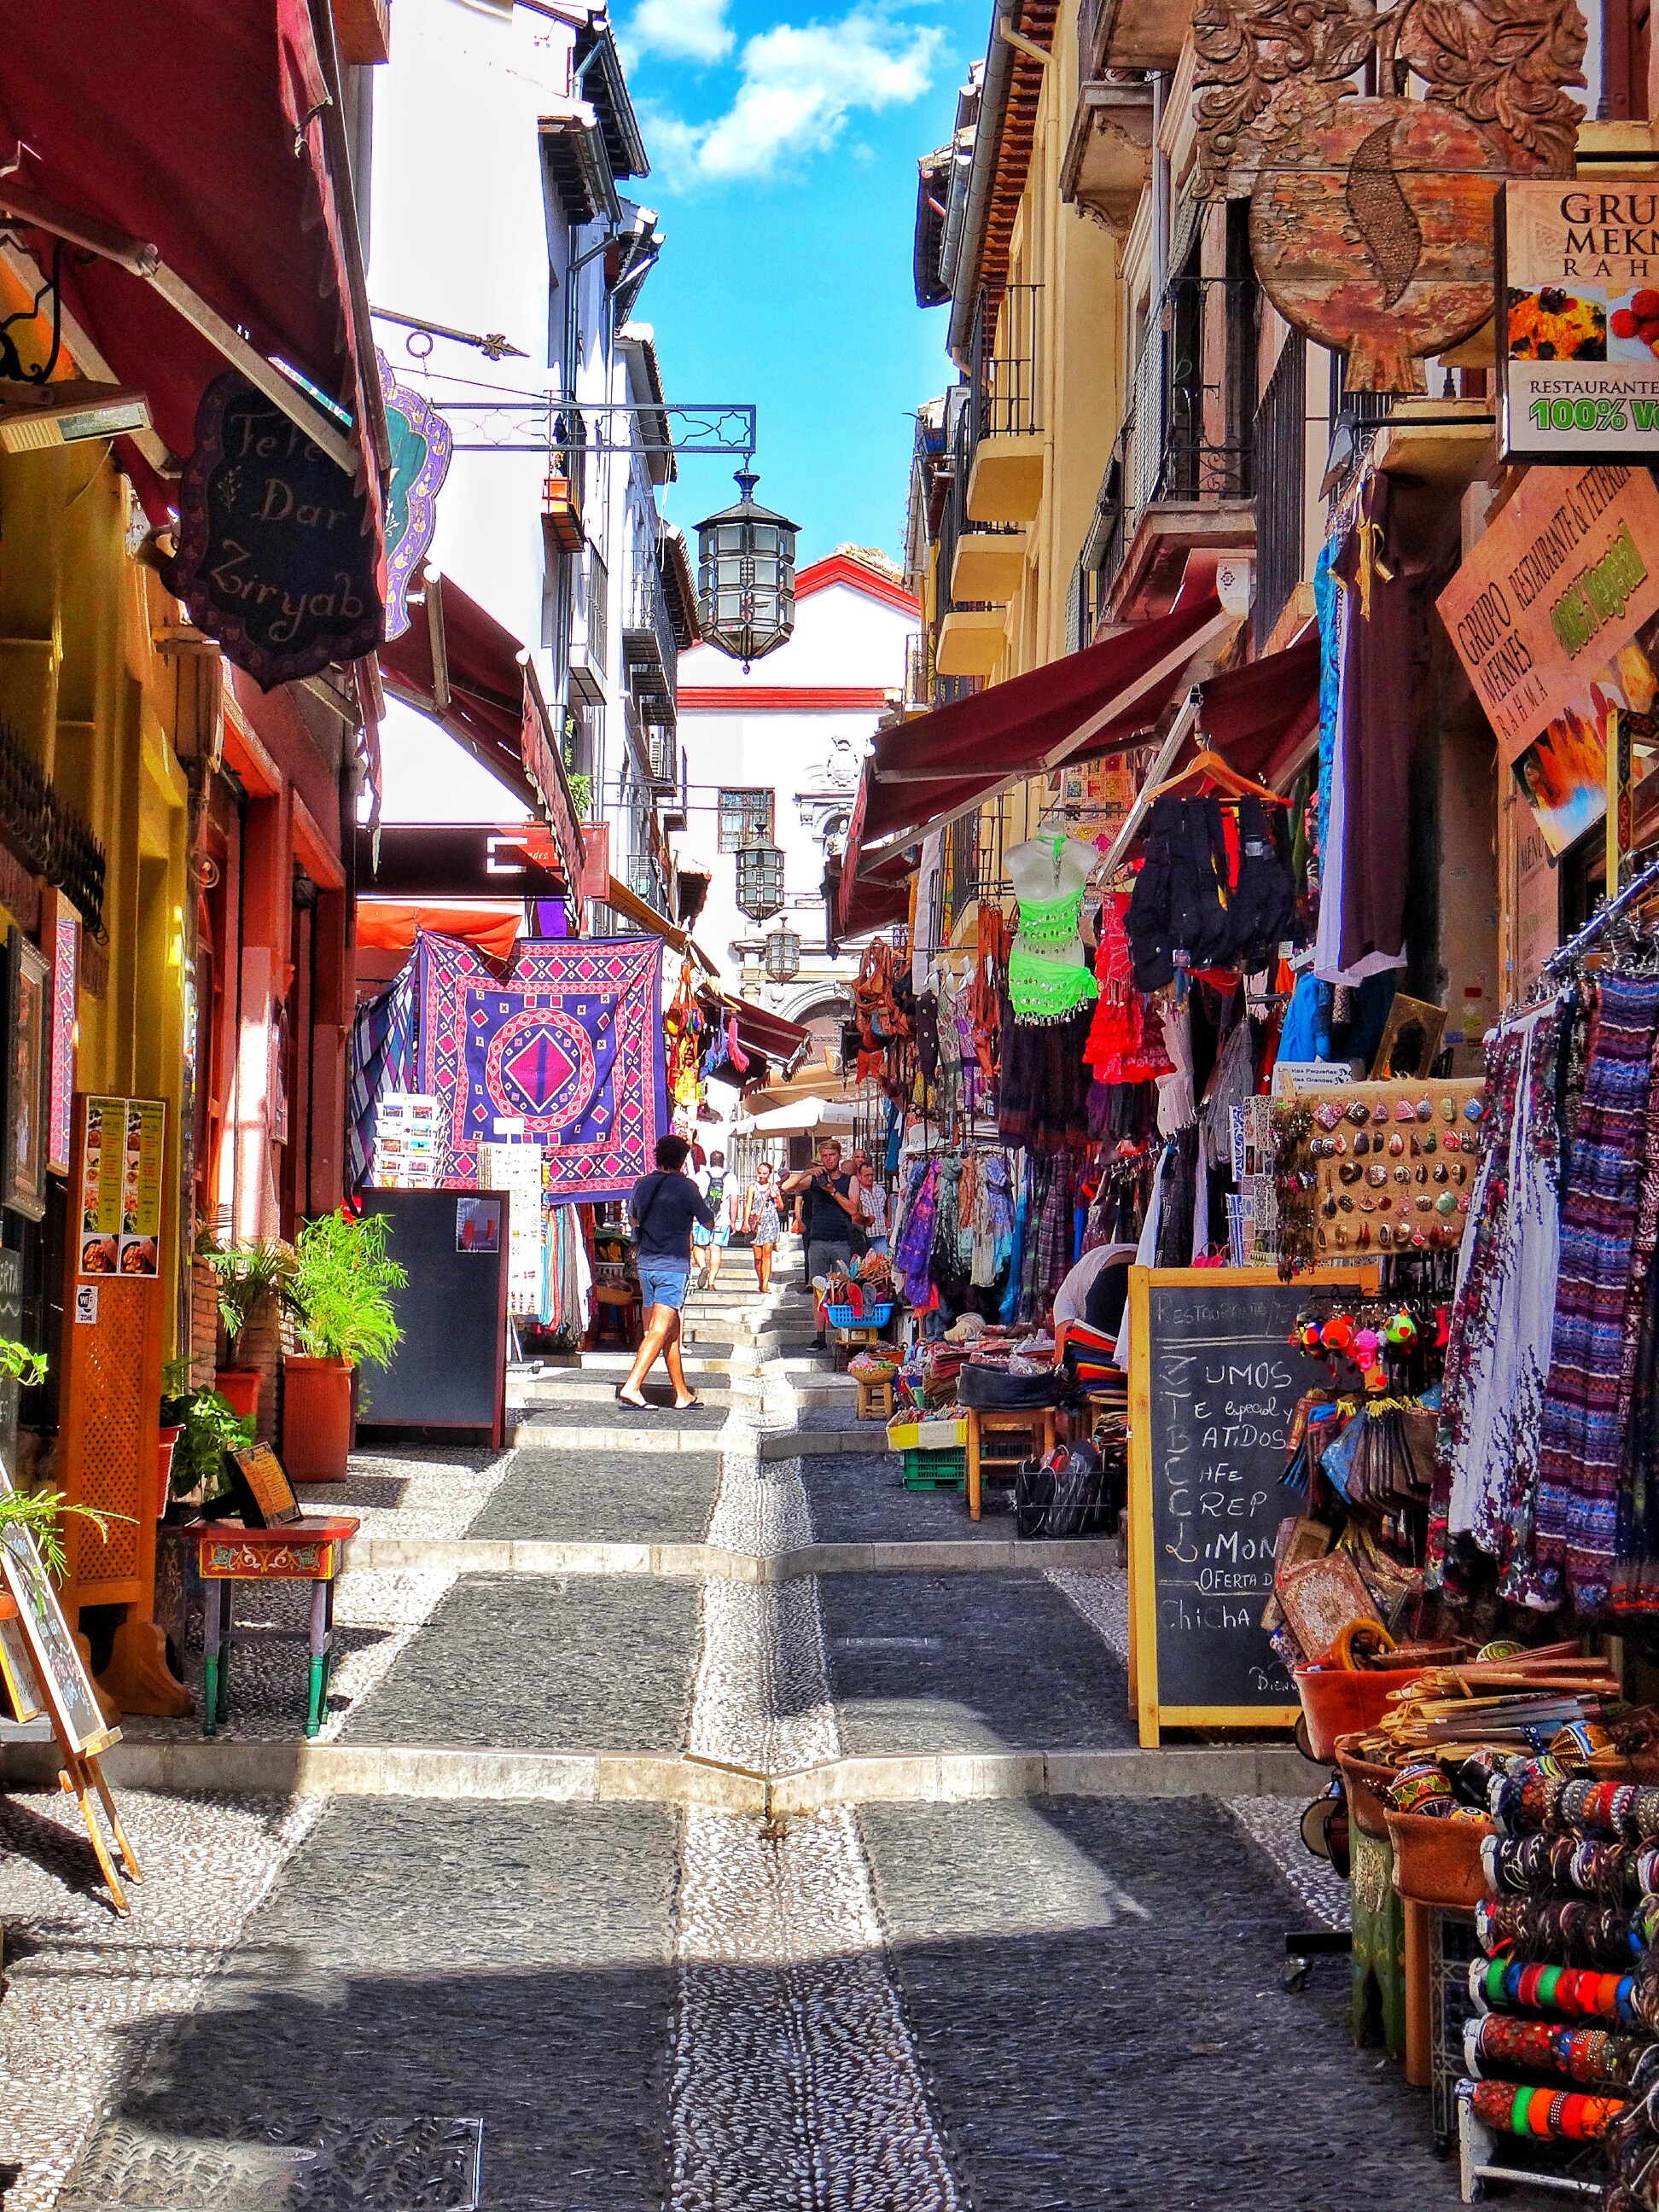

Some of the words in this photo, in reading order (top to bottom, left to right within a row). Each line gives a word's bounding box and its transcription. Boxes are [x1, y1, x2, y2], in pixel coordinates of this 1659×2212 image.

[1560, 194, 1657, 224] GRU
[1563, 259, 1650, 277] RAH
[1529, 381, 1659, 394] RESTAURANTE
[1529, 398, 1627, 431] 100%
[251, 478, 346, 529] Dar
[211, 538, 364, 642] Ziryab
[1458, 582, 1511, 666] GRUPO
[1508, 505, 1580, 612] RESTAURANTE
[1565, 488, 1591, 534] &
[1479, 628, 1533, 709] MEKNES
[1495, 675, 1549, 740] RAHMA
[1159, 1355, 1292, 1389] ZUMOS
[1225, 1396, 1279, 1422] especial
[1168, 1488, 1267, 1517] CREP
[1199, 1568, 1258, 1591] OFERTA
